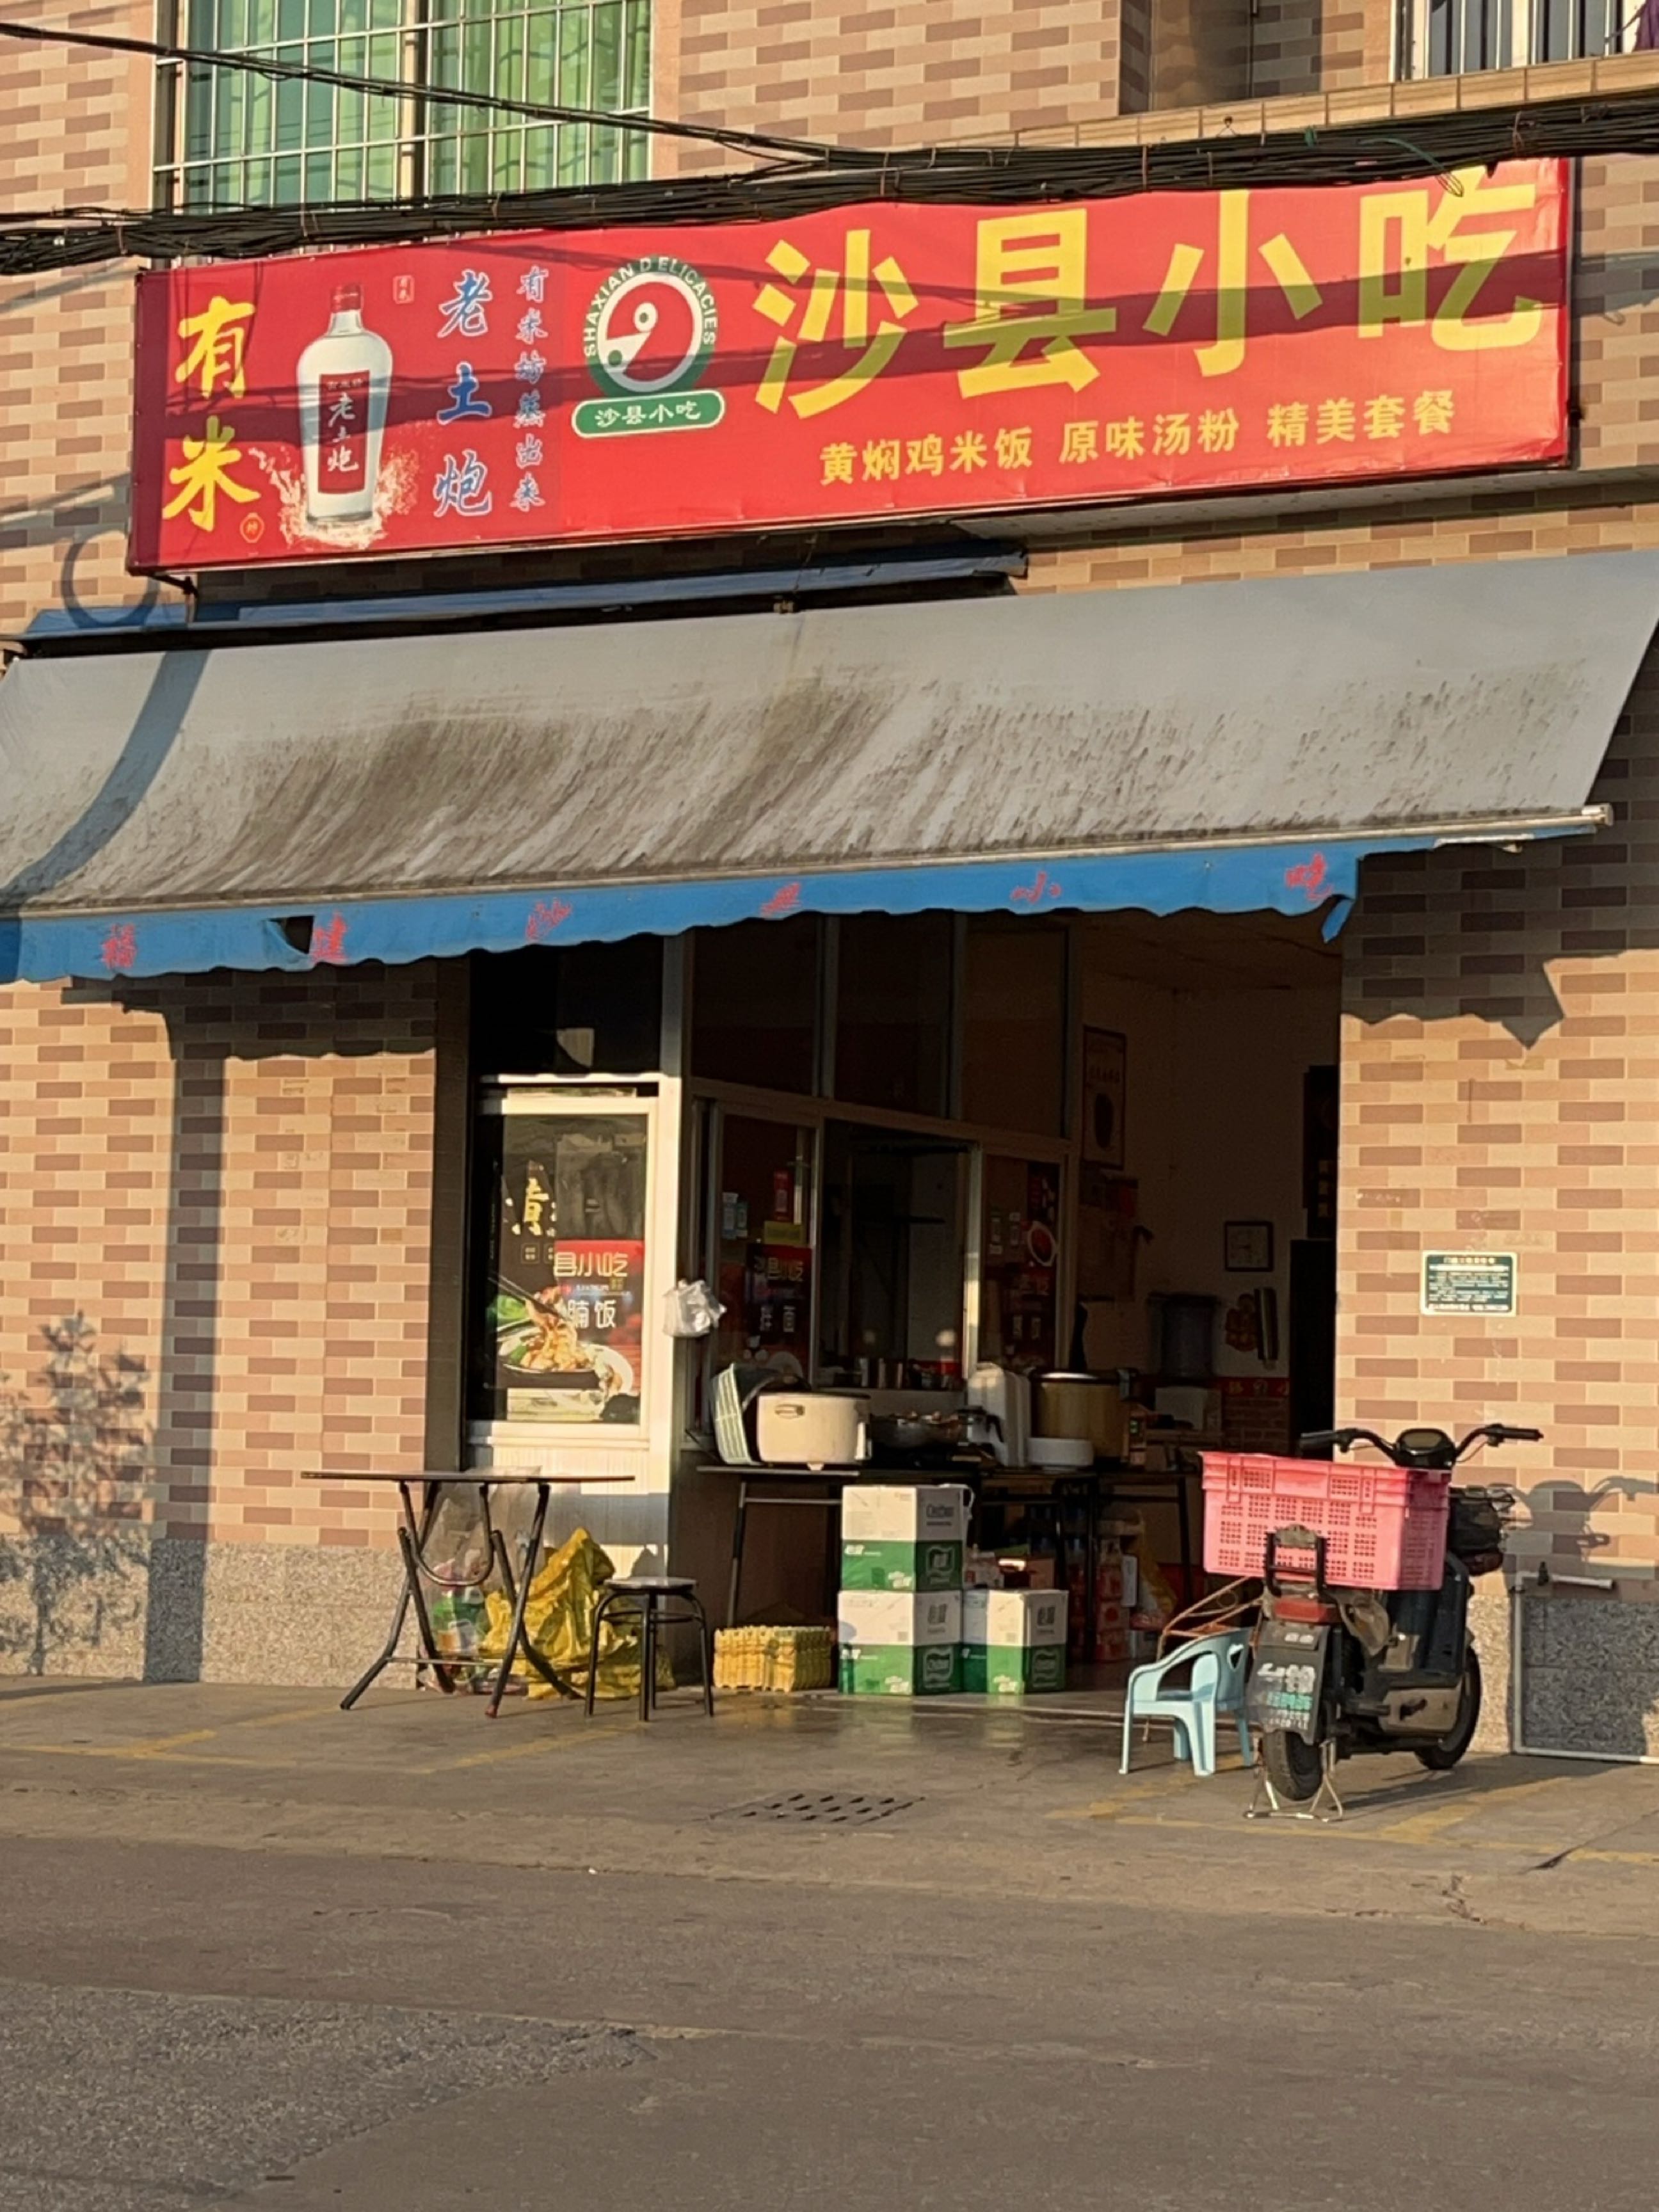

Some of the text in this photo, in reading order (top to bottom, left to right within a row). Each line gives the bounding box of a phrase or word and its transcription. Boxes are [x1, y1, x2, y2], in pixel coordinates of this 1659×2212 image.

[583, 256, 717, 357] SHAXIAN DELICACIES
[752, 165, 1543, 420] 沙县小吃
[161, 296, 260, 531] 有米
[433, 268, 493, 518] 老土炮
[594, 400, 701, 428] 沙县小吃
[821, 389, 1456, 485] 黄焖鸡米饭 原味汤粉 精美套餐
